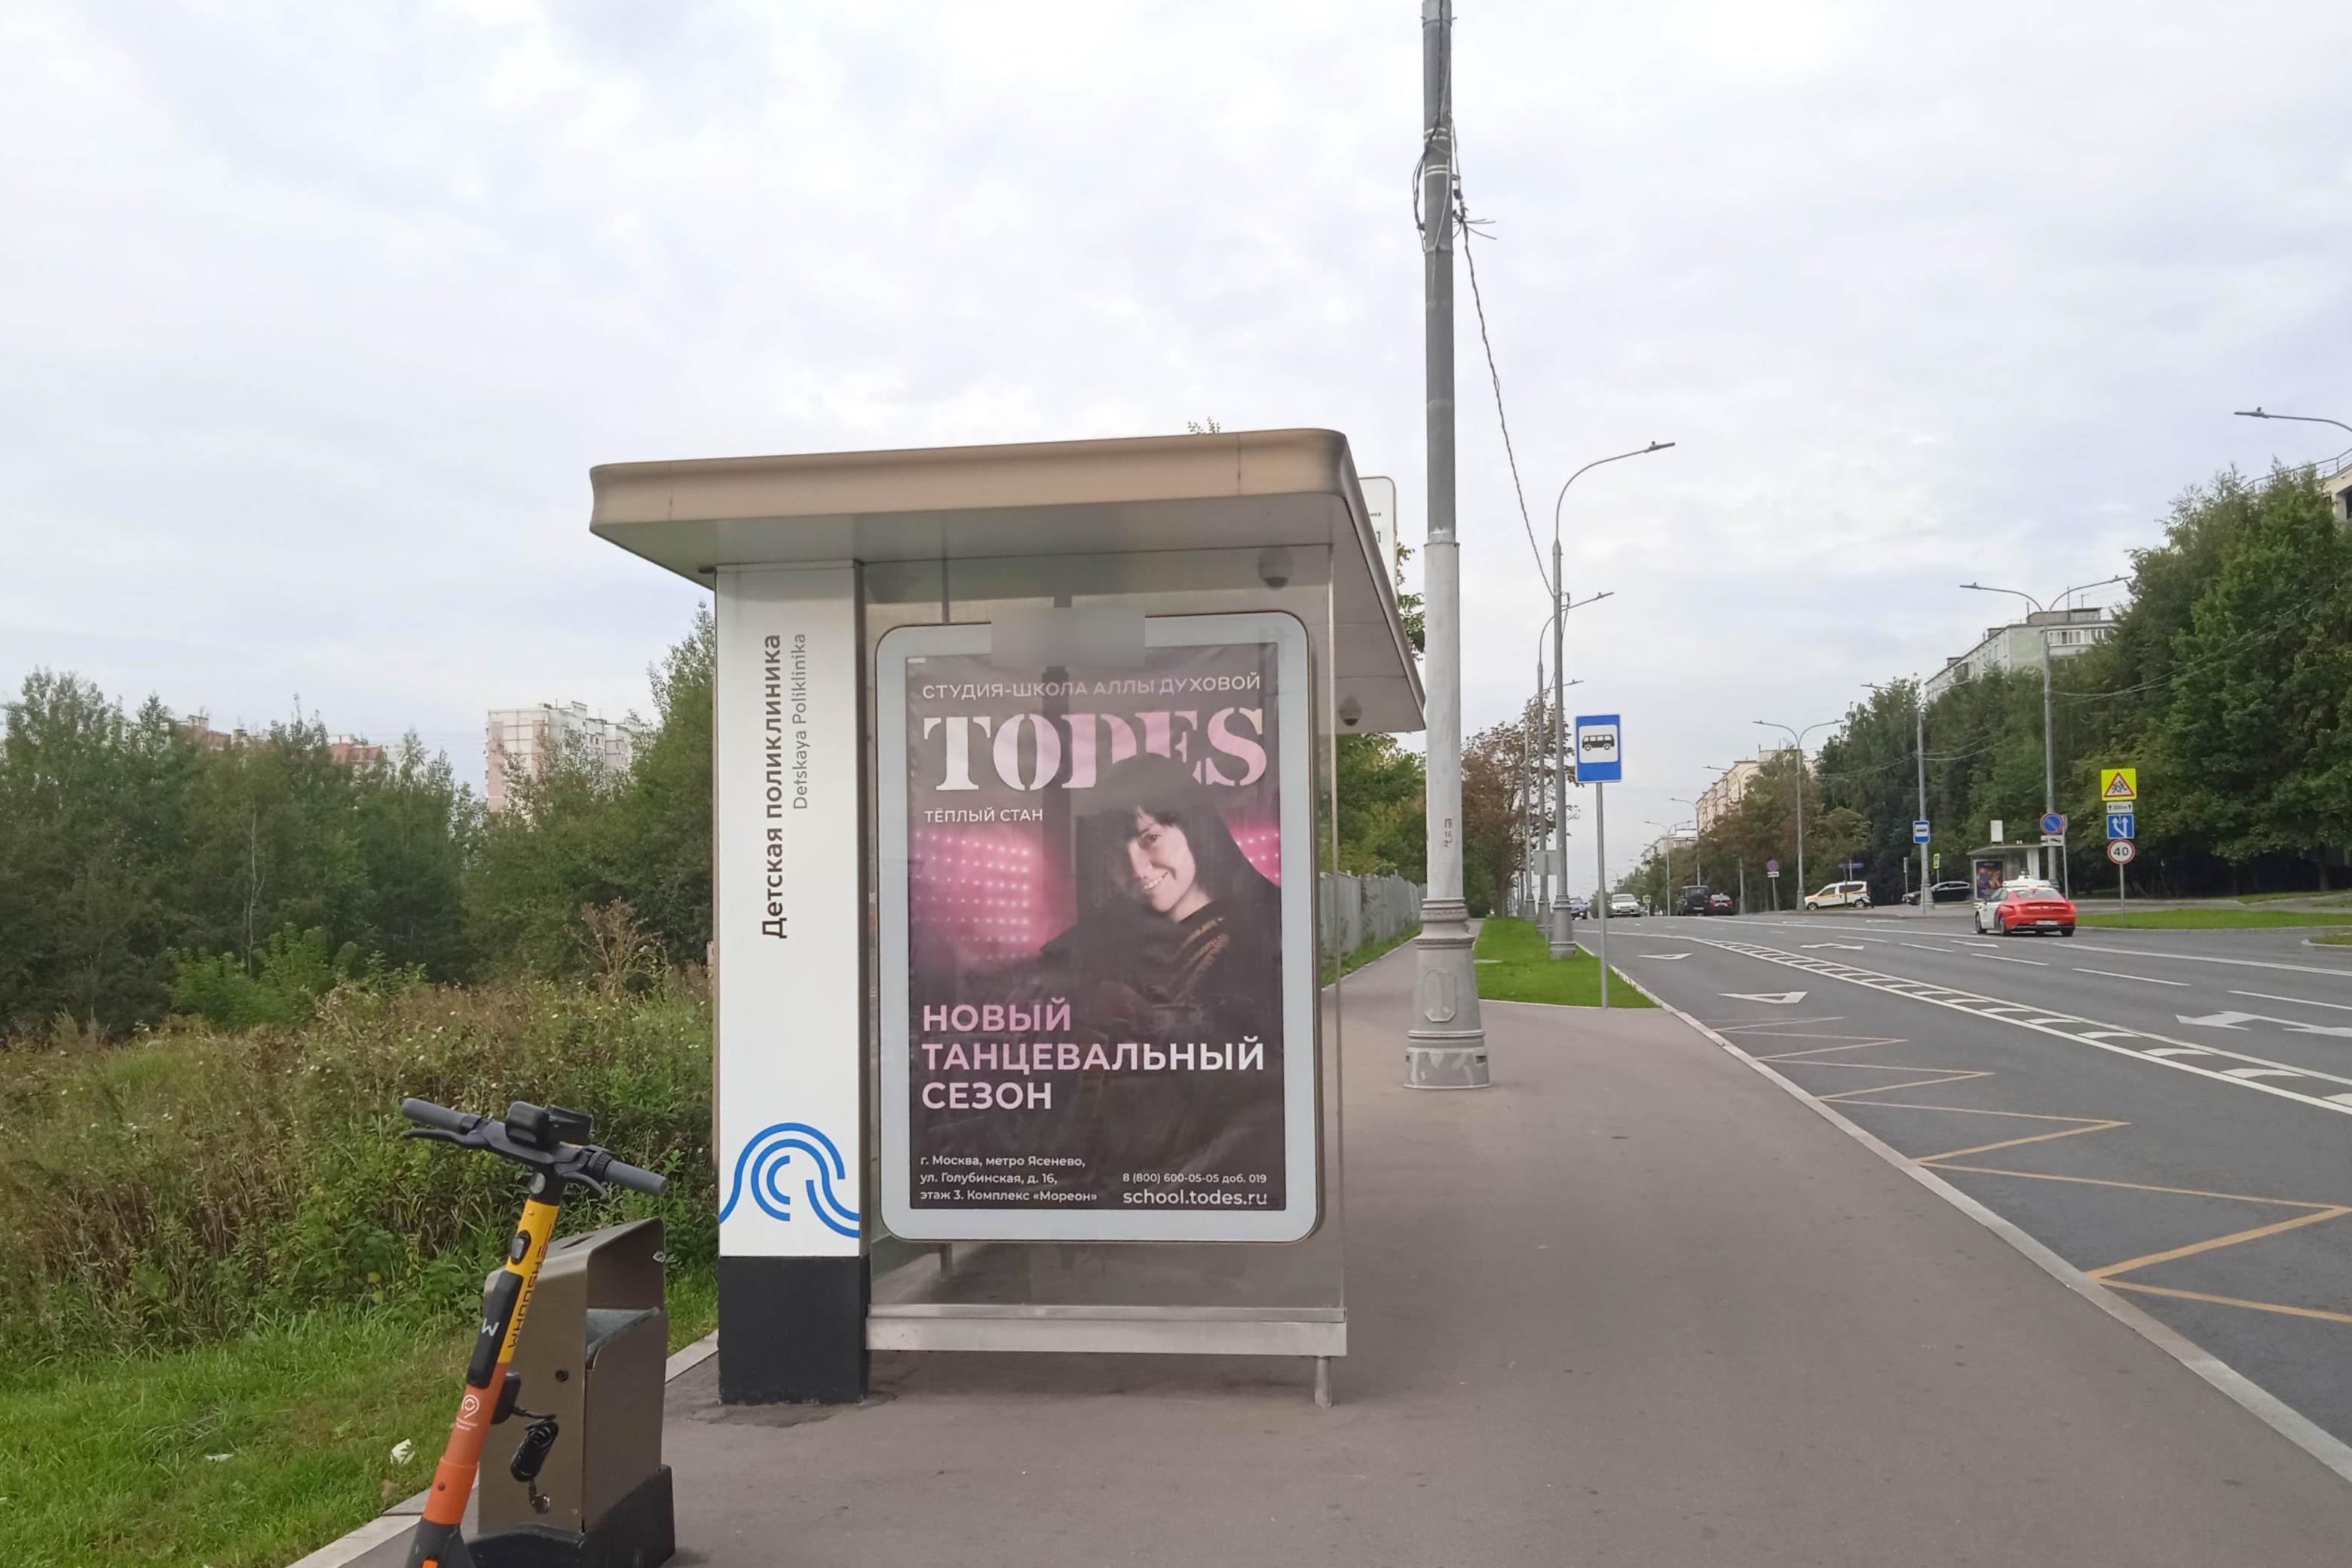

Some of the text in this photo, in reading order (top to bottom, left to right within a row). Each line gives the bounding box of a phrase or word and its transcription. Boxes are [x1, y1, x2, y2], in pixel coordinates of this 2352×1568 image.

[922, 672, 1260, 700] СТУДИЯ-ШКОЛА АЛЛЫ ДУХОВОЙ
[791, 633, 810, 810] Detskaya Poliklinika
[923, 706, 1268, 792] TODES
[762, 634, 788, 939] Детская поликлиника
[924, 807, 1043, 824] ТЁПЛЫЙ СТАН
[2113, 847, 2130, 856] 40
[922, 997, 1071, 1033] НОВЫЙ
[921, 1036, 1265, 1076] ТАНЦЕВАЛЬНЫЙ
[921, 1082, 1052, 1110] СЕЗОН
[920, 1156, 1086, 1168] г. Москва, метро Ясенево,
[920, 1172, 1058, 1186] ул. Голубинская, д. 16,
[1122, 1172, 1267, 1184] 8 (800) 600-05-05 доб. 019
[920, 1190, 1098, 1203] этаж 3. Комплекс «Мореон»
[1122, 1188, 1268, 1205] school.todes.ru
